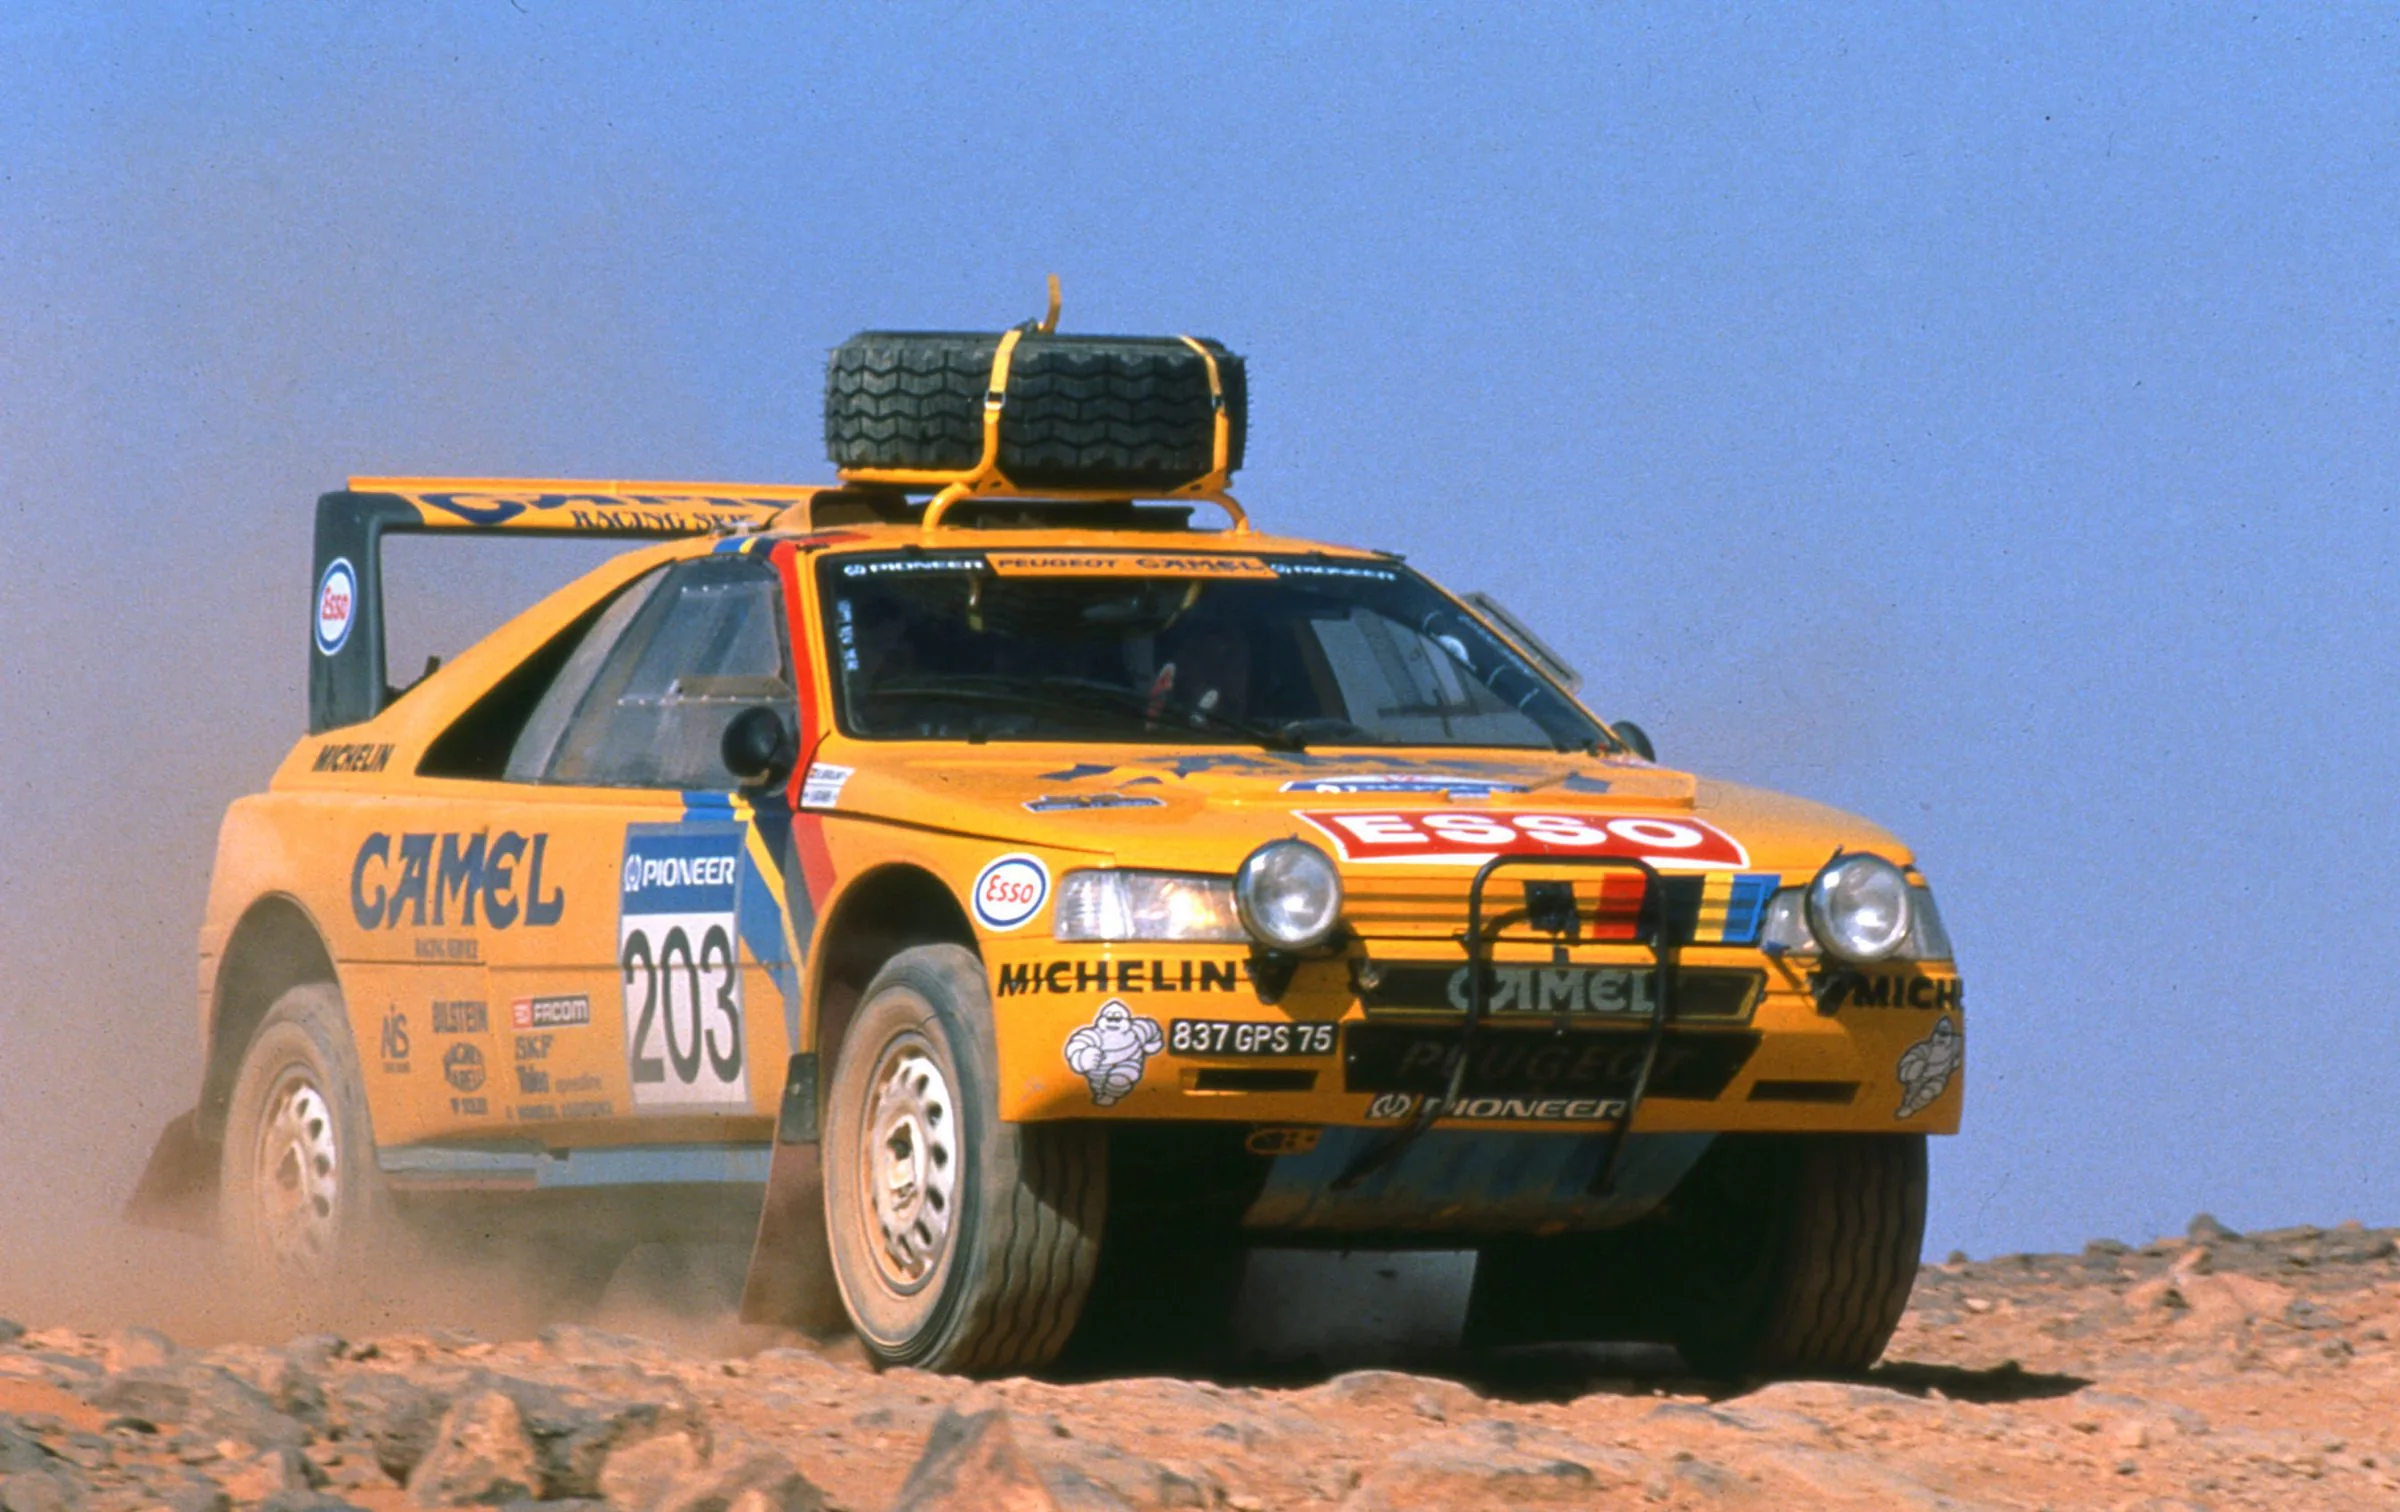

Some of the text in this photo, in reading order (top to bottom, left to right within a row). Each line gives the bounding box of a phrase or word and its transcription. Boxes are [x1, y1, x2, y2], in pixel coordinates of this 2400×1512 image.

[869, 560, 984, 573] PIONEER
[999, 558, 1265, 572] PEUGEOT CAMEL
[311, 744, 396, 773] MICHELIN
[1333, 814, 1704, 848] ESSO
[351, 831, 565, 930] CAMEL
[643, 855, 735, 887] PIONEER
[985, 874, 1035, 904] Esso
[997, 960, 1236, 997] MICHELIN
[533, 999, 588, 1023] FACOM
[622, 924, 742, 1085] 203
[1173, 1021, 1333, 1053] 837 GPS 75
